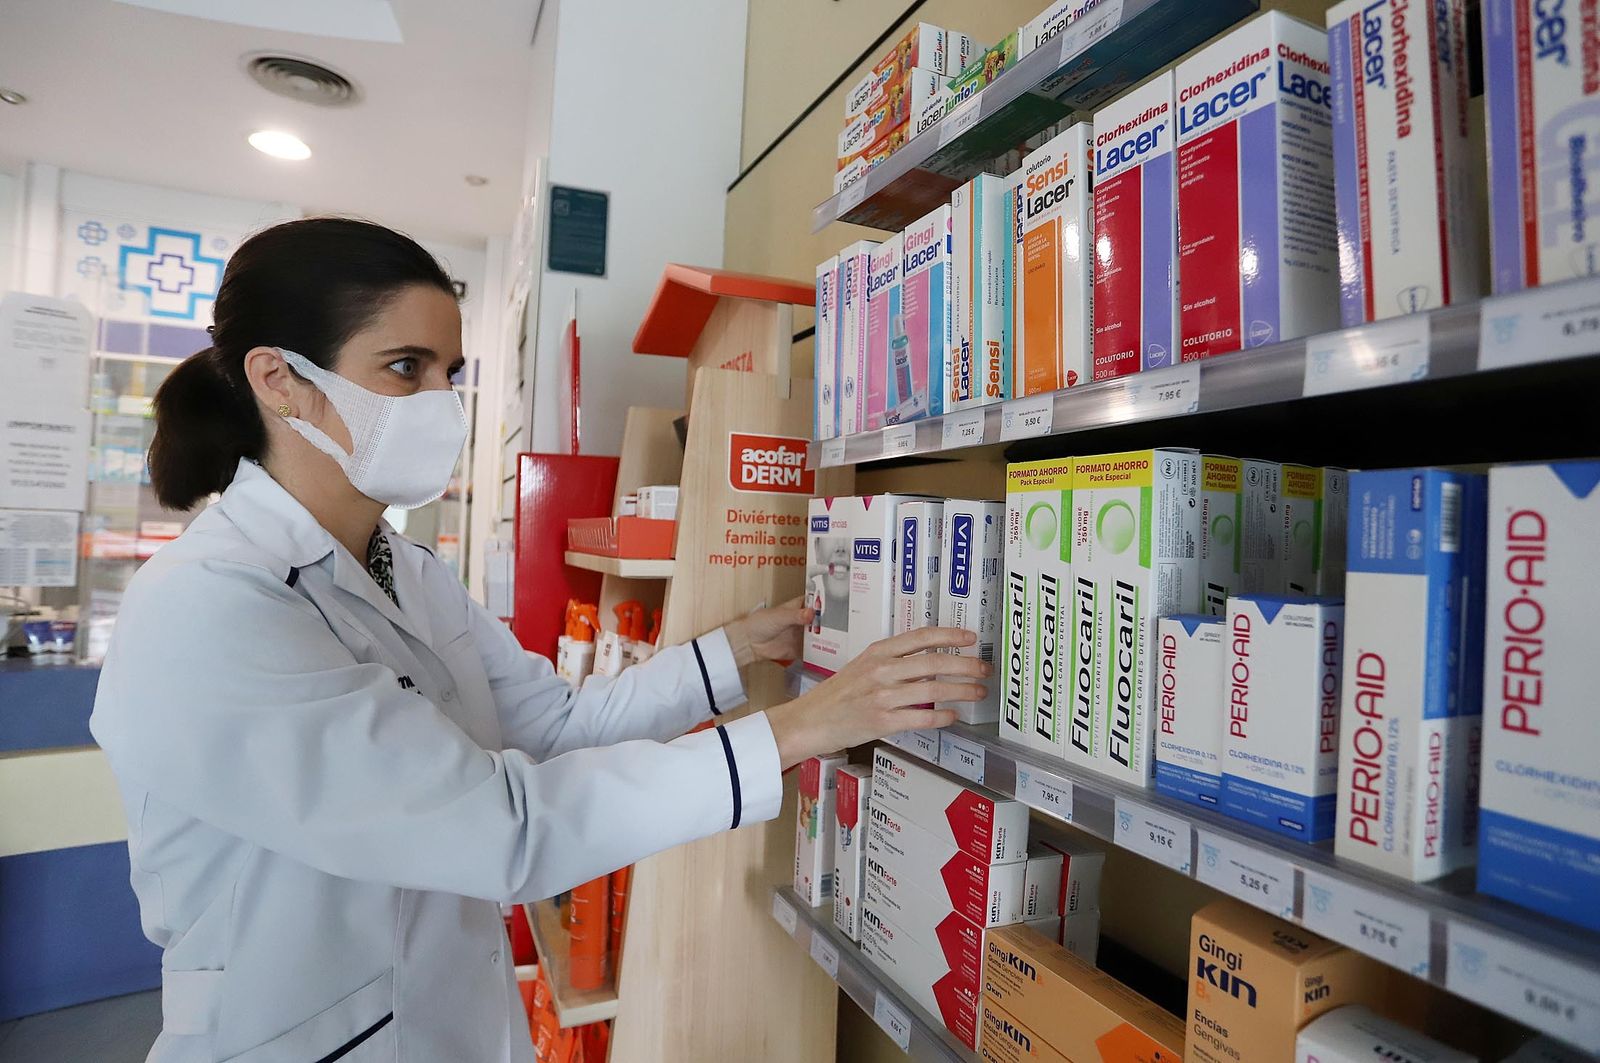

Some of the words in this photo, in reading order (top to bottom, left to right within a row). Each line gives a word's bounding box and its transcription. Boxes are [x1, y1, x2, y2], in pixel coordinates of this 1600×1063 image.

[1035, 14, 1072, 48] Lacer
[1363, 0, 1387, 88] Lacer
[1278, 43, 1330, 75] Clorhexi
[1180, 47, 1270, 103] Clorhexidina
[916, 105, 944, 134] Lacer
[944, 80, 977, 116] júnior
[1180, 71, 1266, 136] Lacer
[1097, 102, 1168, 147] Clorhexidina
[1097, 122, 1166, 176] Lacer
[1026, 154, 1051, 175] colutorio
[1026, 152, 1068, 198] Sensi
[1027, 178, 1074, 219] Lacer
[905, 223, 934, 252] Gingi
[870, 247, 893, 273] Gingi
[905, 241, 941, 272] Lacer
[846, 257, 854, 311] Lacer
[870, 264, 898, 292] Lacer
[822, 272, 830, 321] Lacer
[1183, 302, 1193, 312] Sin
[1194, 297, 1216, 309] alcohol
[1104, 321, 1121, 333] alcohol
[1183, 328, 1232, 347] COLUTORIO
[1096, 350, 1134, 366] COLUTORIO
[1183, 352, 1198, 363] 500
[1200, 349, 1210, 360] ml
[952, 348, 960, 402] Sensi
[959, 337, 969, 401] Lacer
[986, 340, 1000, 398] Sensi
[1096, 369, 1108, 379] 500
[1176, 390, 1181, 398] €
[886, 413, 900, 426] Lacer
[741, 445, 805, 466] acofar
[741, 465, 801, 487] DERM
[1009, 469, 1038, 479] FORMATO
[1040, 466, 1068, 476] AHORRO
[1076, 463, 1111, 474] FORMATO
[1113, 460, 1148, 471] AHORRO
[1106, 473, 1131, 481] Especial
[1205, 462, 1238, 474] FORMATO
[1206, 473, 1236, 482] AHORRO
[1033, 478, 1054, 486] Especial
[727, 509, 800, 525] Diviértete
[812, 520, 828, 528] VITIS
[1084, 510, 1089, 523] mg
[725, 529, 777, 545] familia
[780, 534, 805, 546] con
[709, 550, 754, 568] mejor
[758, 555, 807, 568] protec
[856, 544, 878, 555] VITIS
[906, 524, 914, 586] VITIS
[955, 521, 968, 589] VITIS
[1501, 510, 1546, 736] PERIO·AID
[1006, 572, 1023, 730] Fluocaril
[1036, 573, 1056, 740] Fluocaril
[1072, 576, 1093, 754] Fluocaril
[1109, 580, 1134, 767] Fluocaril
[1230, 614, 1250, 738] PERIO·AID
[1025, 676, 1029, 686] LA
[1058, 683, 1063, 695] LA
[1161, 634, 1176, 734] PERIO·AID
[1095, 693, 1100, 705] LA
[1137, 703, 1142, 716] LA
[1229, 749, 1283, 769] CLORHEXIDINA
[1350, 653, 1386, 846] PERIO·AID
[970, 758, 974, 766] €
[1042, 790, 1054, 802] 7,95
[1055, 795, 1059, 804] €
[1383, 758, 1398, 853] CLORHEXIDINA
[1150, 832, 1166, 846] 9,15
[1167, 838, 1172, 848] €
[1240, 875, 1260, 891] 5,25
[1262, 883, 1269, 895] €
[1199, 934, 1242, 971] Gingi
[1389, 936, 1398, 948] €
[1304, 975, 1324, 988] Gingi
[1195, 1009, 1228, 1038] Encías
[1194, 1024, 1240, 1061] Gengivas
